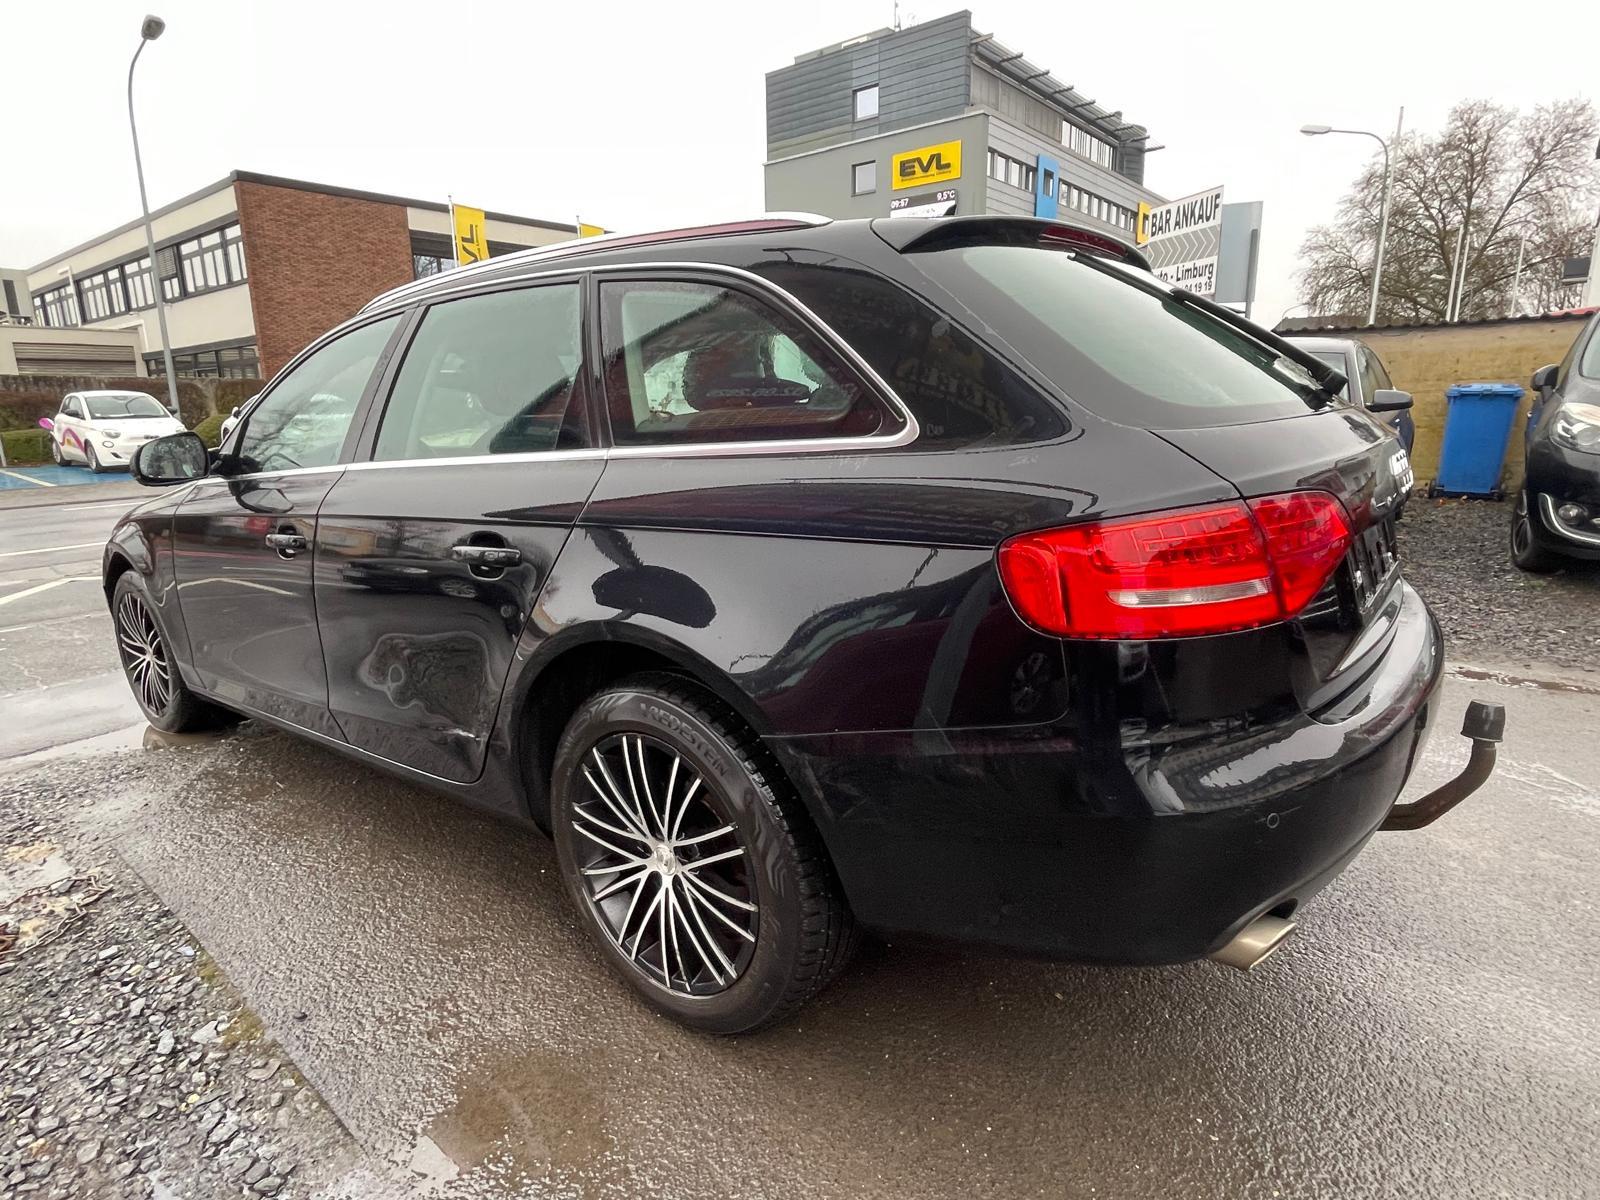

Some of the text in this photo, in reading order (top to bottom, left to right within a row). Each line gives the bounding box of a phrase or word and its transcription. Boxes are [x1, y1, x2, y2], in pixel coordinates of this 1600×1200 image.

[900, 153, 951, 177] EVL
[1151, 193, 1221, 238] BAR ANKAUF
[1176, 262, 1214, 282] Limburg
[1194, 281, 1203, 293] 19
[1204, 280, 1213, 291] 19
